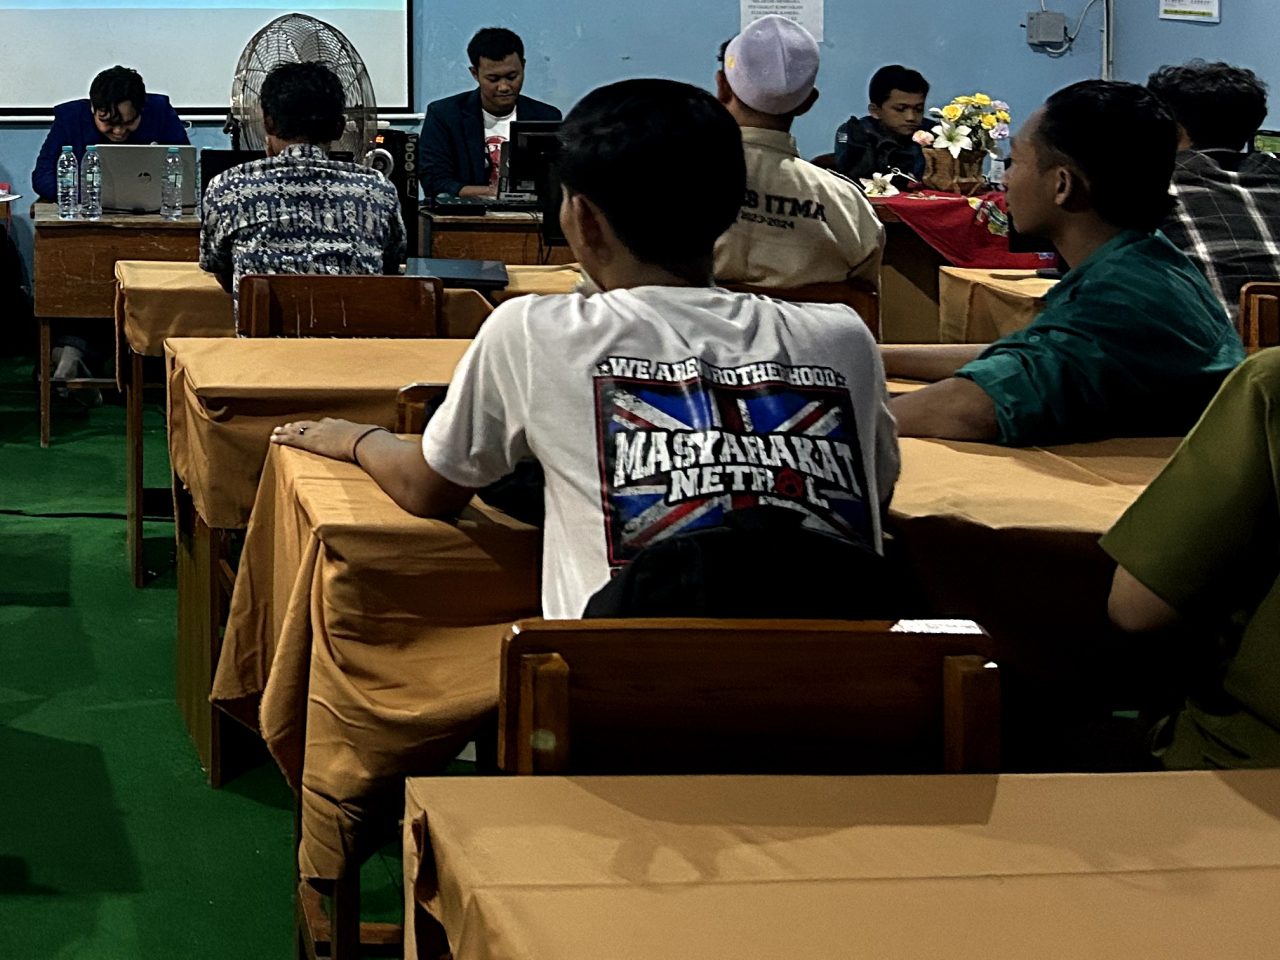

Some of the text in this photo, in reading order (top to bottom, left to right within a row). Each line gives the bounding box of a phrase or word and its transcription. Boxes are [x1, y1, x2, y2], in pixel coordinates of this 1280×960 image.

[765, 193, 827, 223] ITMA
[608, 356, 650, 380] WE
[655, 358, 699, 382] ARE
[613, 430, 863, 498] MASYARAKAT
